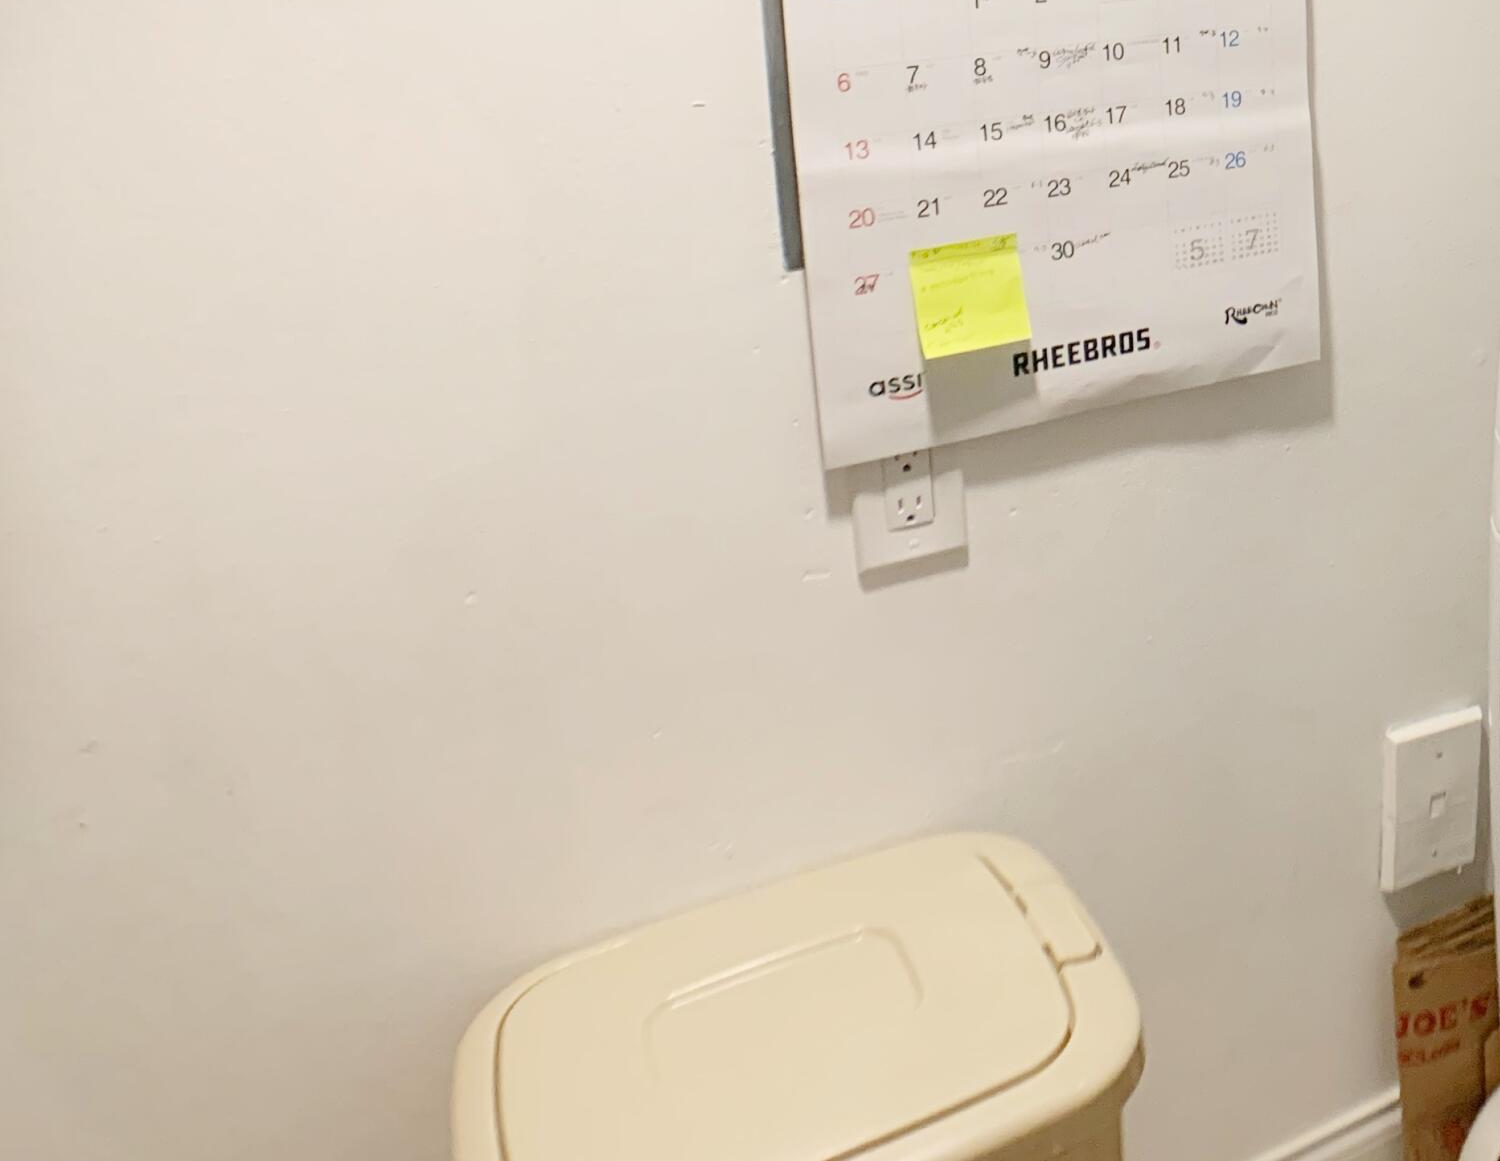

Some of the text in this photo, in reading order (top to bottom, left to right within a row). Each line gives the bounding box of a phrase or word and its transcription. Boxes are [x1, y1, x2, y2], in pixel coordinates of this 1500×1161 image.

[838, 73, 851, 92] 6
[907, 65, 919, 83] 7
[975, 58, 986, 76] 8
[1039, 51, 1050, 68] 9
[1103, 43, 1124, 61] 10
[1163, 36, 1180, 54] 11
[1221, 30, 1239, 47] 12
[845, 140, 869, 160] 13
[913, 131, 936, 151] 14
[980, 122, 1002, 141] 15
[1044, 114, 1066, 132] 16
[1106, 106, 1126, 124] 17
[1166, 98, 1185, 116] 18
[1223, 91, 1241, 108] 19
[849, 208, 875, 229] 20
[918, 198, 939, 218] 21
[984, 188, 1007, 207] 22
[1047, 178, 1072, 198] 23
[1109, 169, 1131, 188] 24
[1168, 160, 1190, 178] 25
[1225, 151, 1246, 170] 26
[1052, 241, 1074, 260] 30
[1190, 238, 1205, 261] 5
[1245, 229, 1259, 250] 7
[1011, 327, 1151, 377] RHEEBROS
